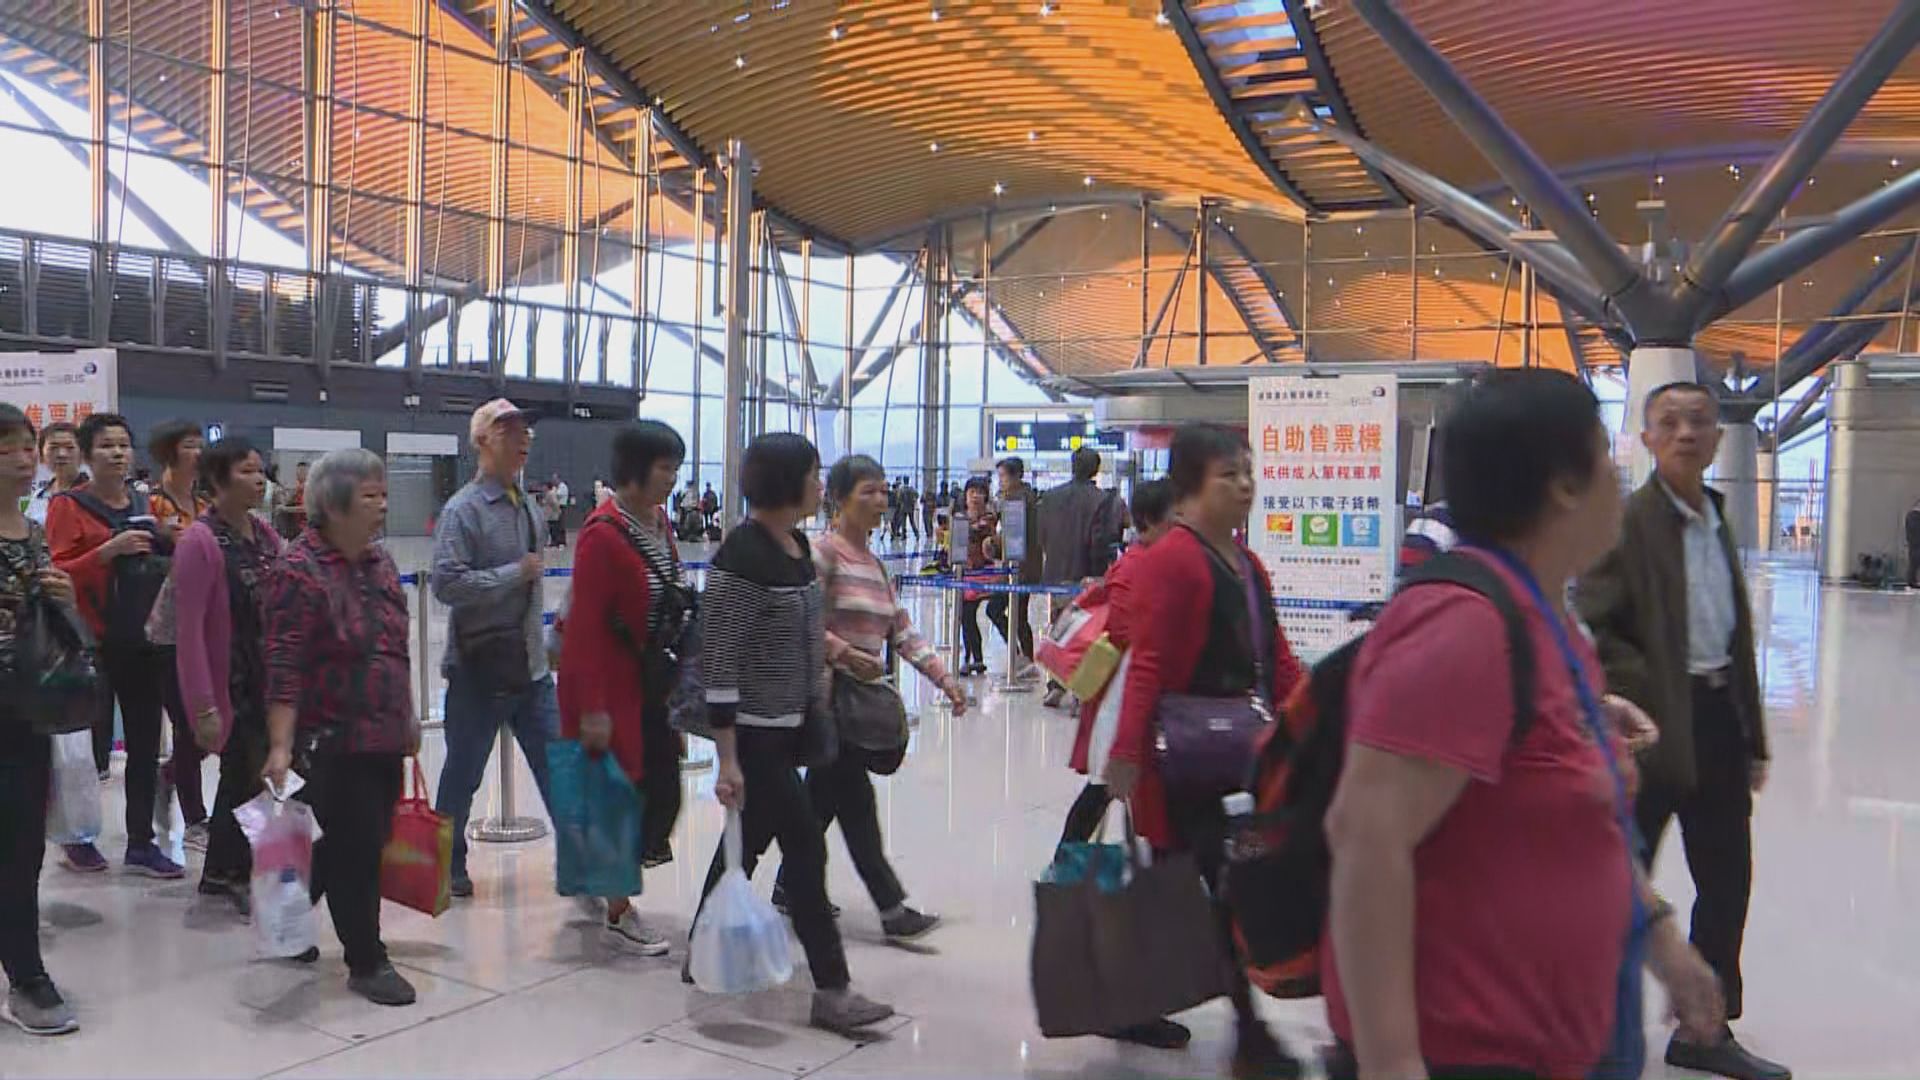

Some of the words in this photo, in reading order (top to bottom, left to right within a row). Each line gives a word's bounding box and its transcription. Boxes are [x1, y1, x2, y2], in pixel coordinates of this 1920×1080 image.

[1263, 423, 1381, 452] 自助售票機
[1263, 495, 1380, 510] 接受以下電子貨幣
